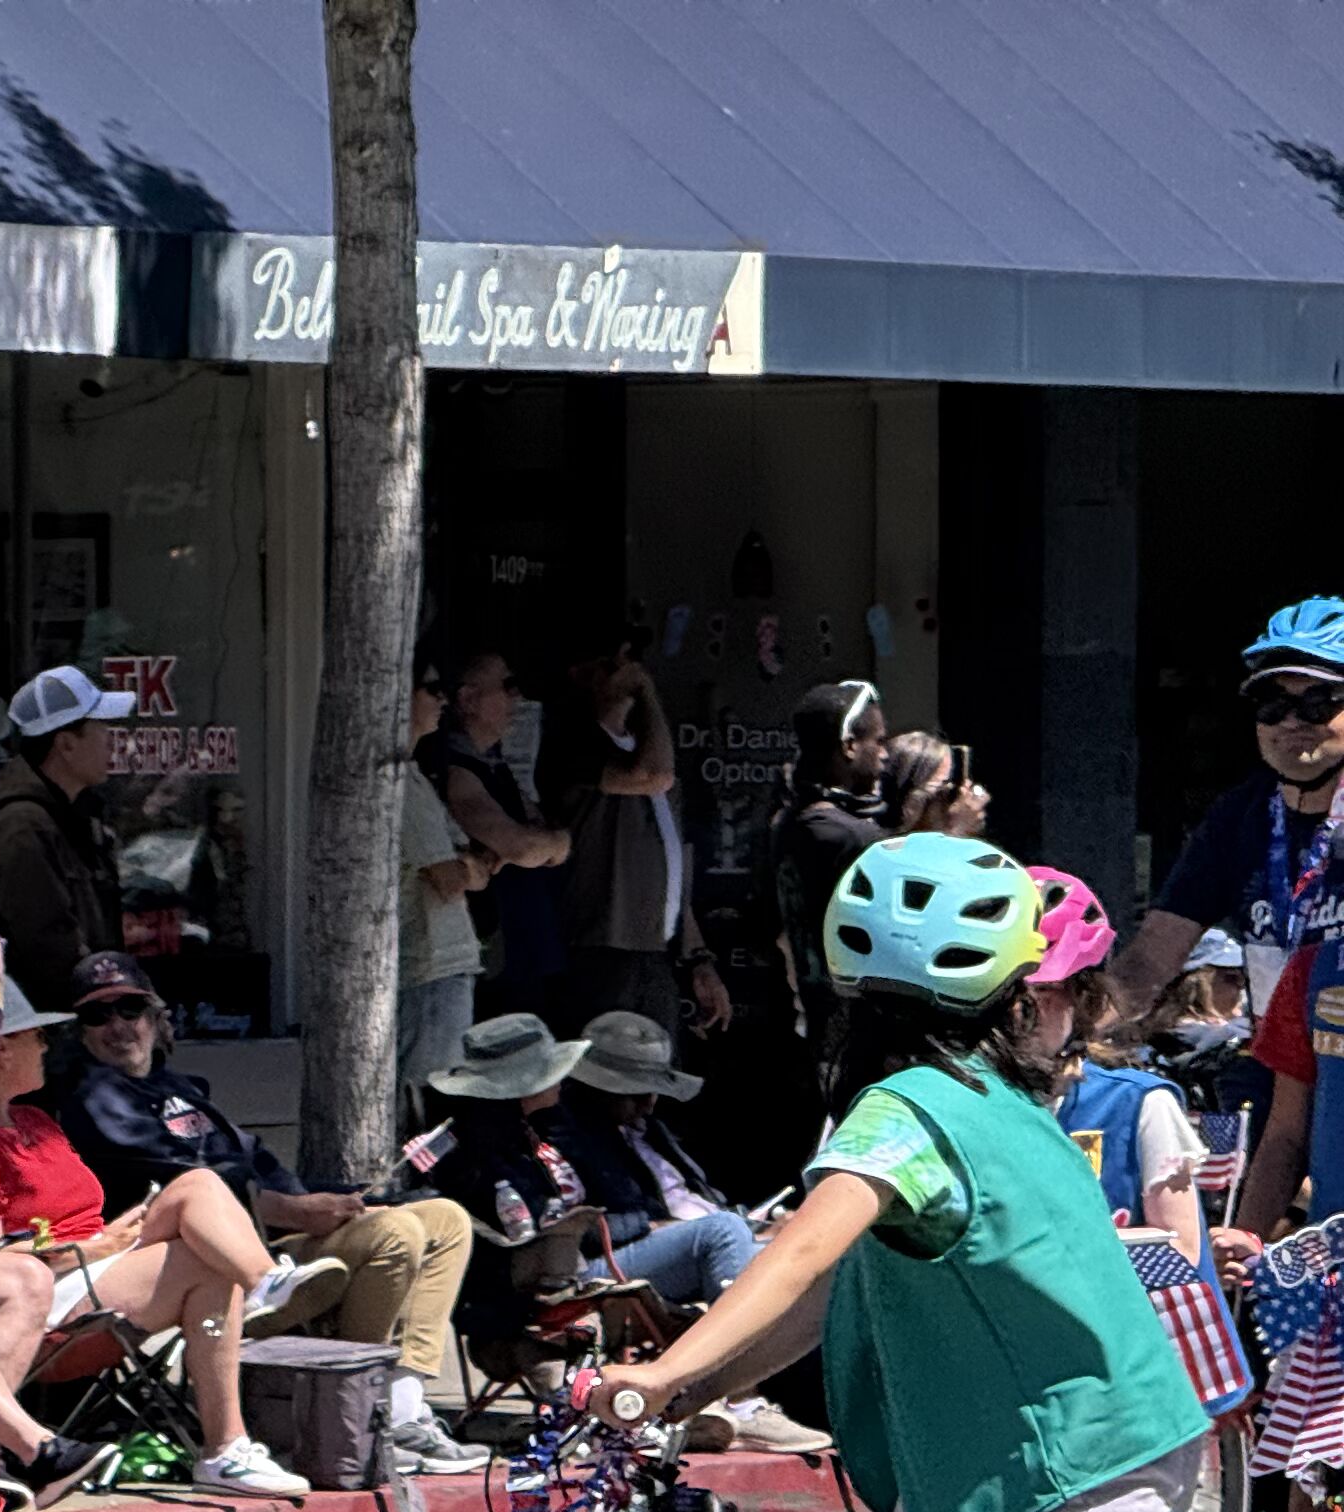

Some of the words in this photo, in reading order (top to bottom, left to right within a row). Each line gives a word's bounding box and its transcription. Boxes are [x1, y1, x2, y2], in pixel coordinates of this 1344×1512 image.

[469, 267, 536, 363] Spa
[545, 261, 579, 348] &
[581, 267, 709, 372] Waxing
[205, 726, 240, 775] SPA
[678, 722, 713, 749] Dr.
[727, 718, 800, 750] Danie
